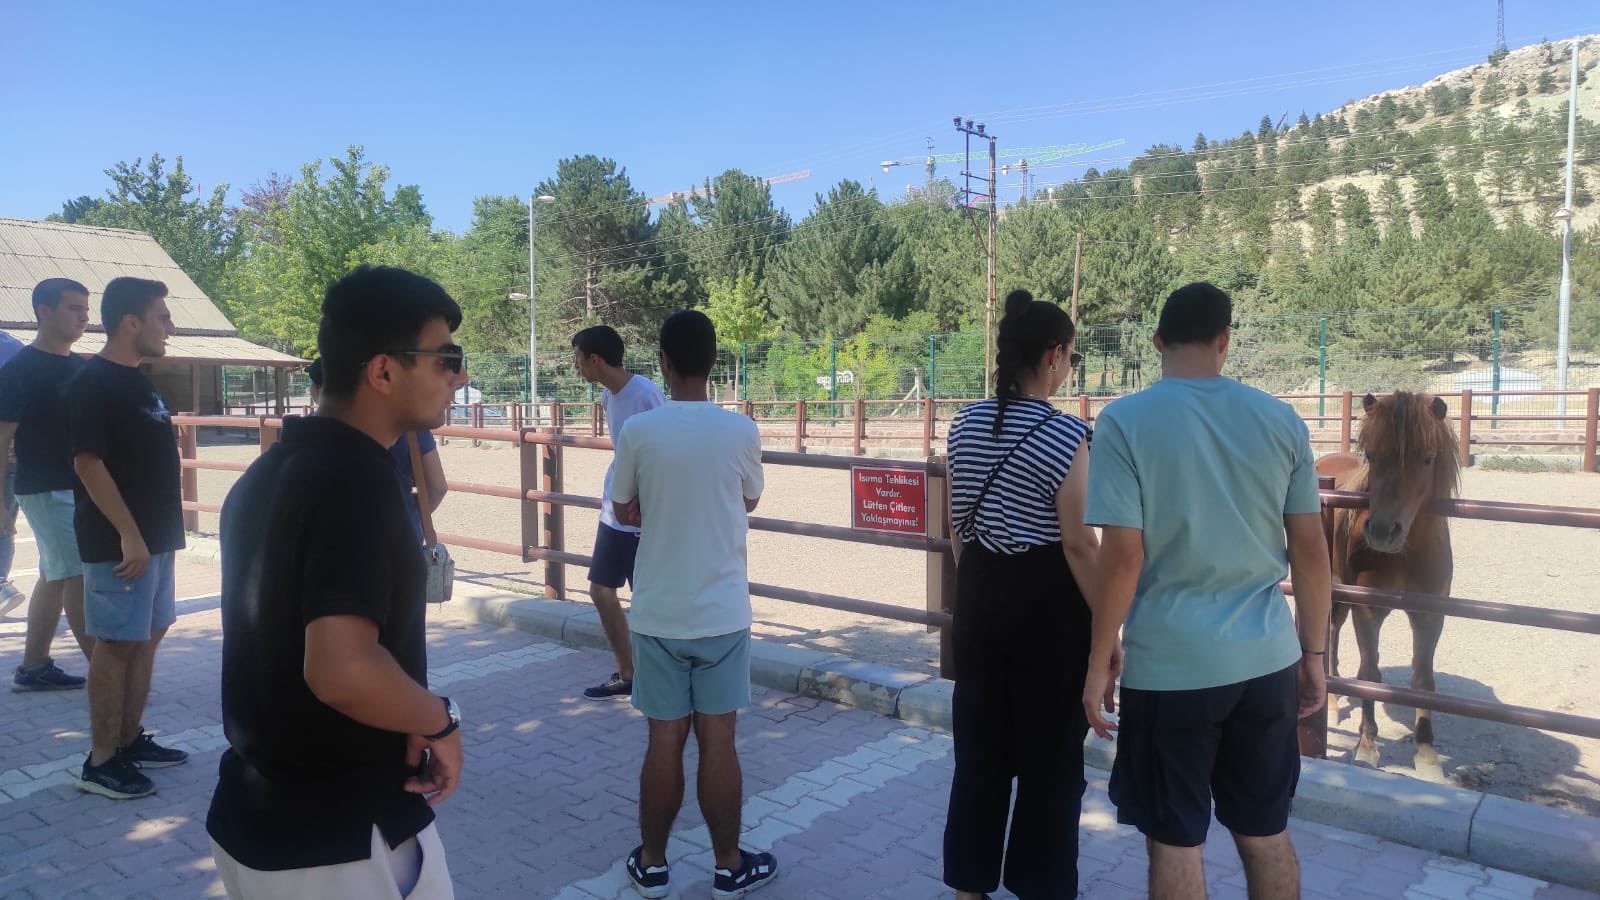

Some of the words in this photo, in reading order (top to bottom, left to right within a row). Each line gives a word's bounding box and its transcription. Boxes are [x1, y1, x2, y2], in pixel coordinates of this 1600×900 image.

[859, 473, 883, 484] Isırma
[885, 474, 919, 486] Tehlikesi
[876, 487, 902, 498] Vardır.
[863, 499, 888, 510] Lütfen
[890, 501, 916, 513] Çitlere
[861, 512, 919, 527] Yaklaşmayınız!
